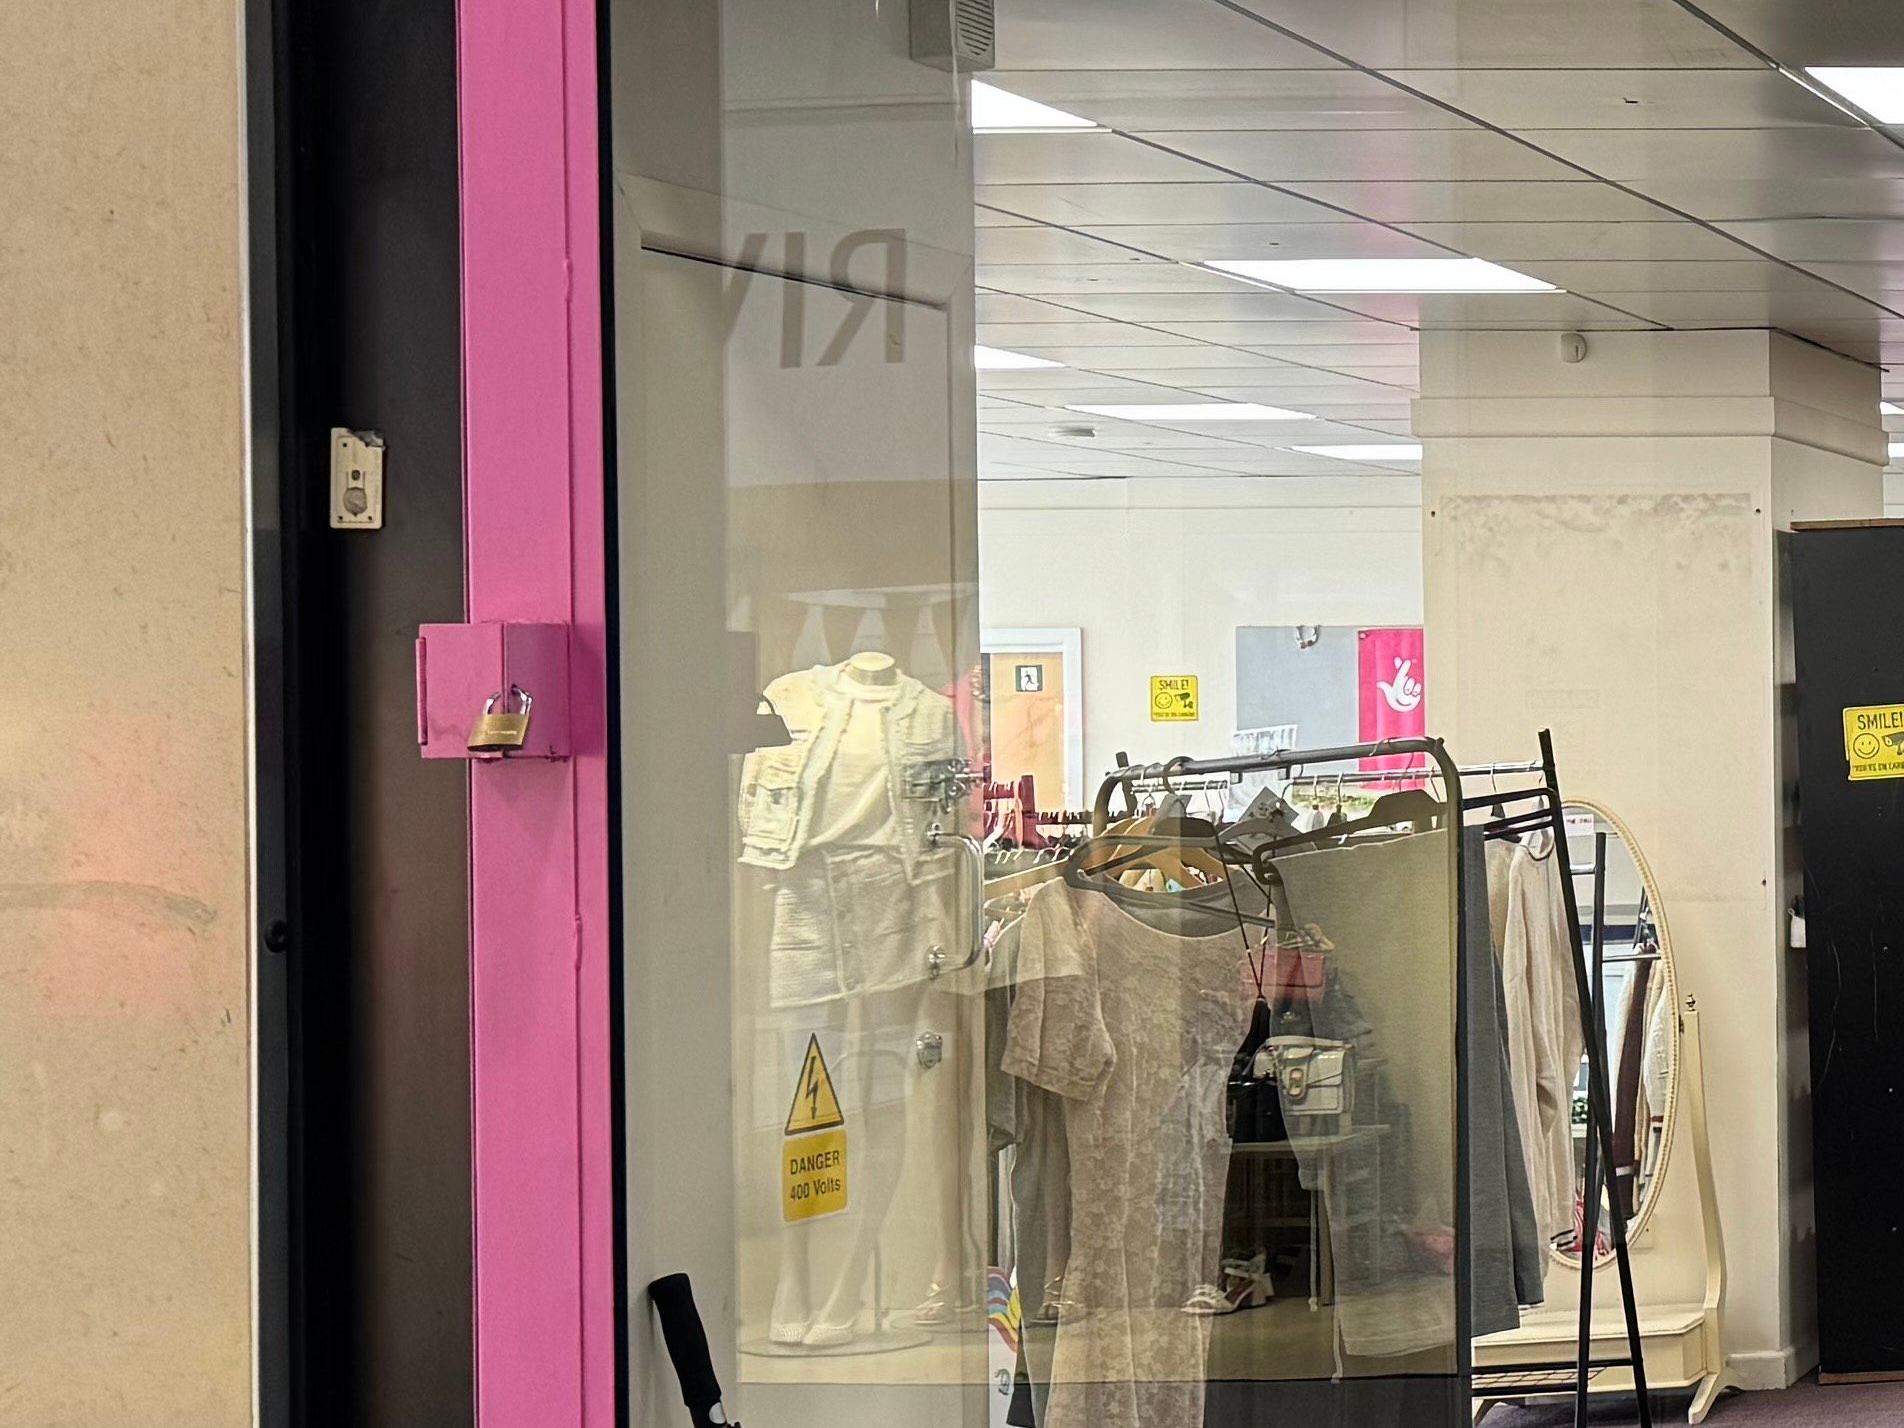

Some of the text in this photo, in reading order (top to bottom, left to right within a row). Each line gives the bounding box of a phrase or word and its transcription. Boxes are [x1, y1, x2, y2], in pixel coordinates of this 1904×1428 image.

[1857, 711, 1903, 730] SMILE!
[790, 1150, 840, 1175] DANGER
[790, 1178, 841, 1201] 400 Volts
